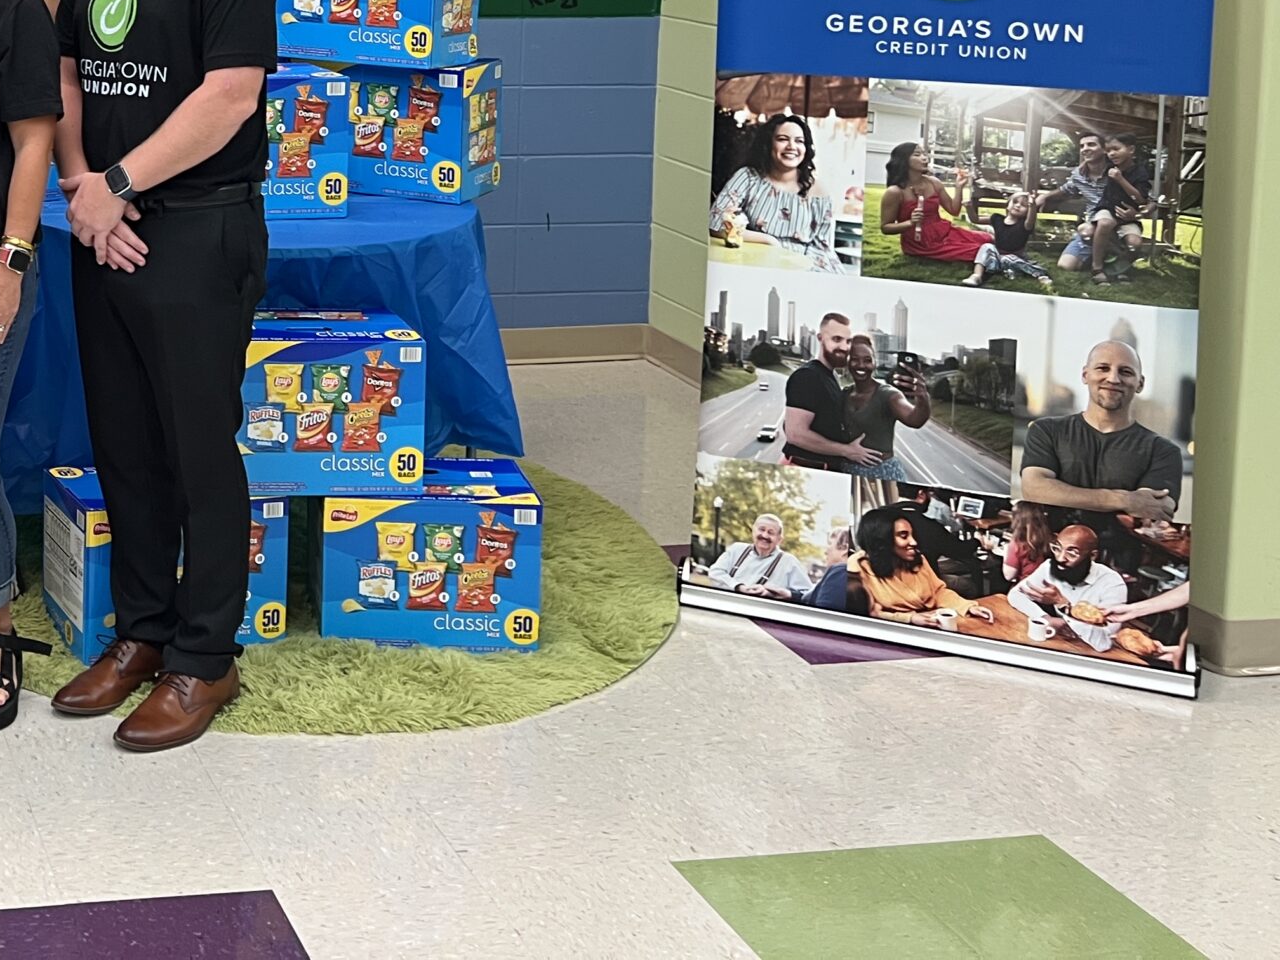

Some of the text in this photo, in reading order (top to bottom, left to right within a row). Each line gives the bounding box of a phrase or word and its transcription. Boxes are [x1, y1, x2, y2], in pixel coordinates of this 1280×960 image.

[349, 28, 402, 45] classic
[825, 13, 1084, 43] GEORGIA'S OWN
[411, 32, 427, 47] 50
[875, 40, 1027, 60] CREDIT UNION
[121, 62, 168, 82] OWN
[374, 161, 428, 180] classic
[439, 167, 455, 182] 50
[325, 179, 342, 194] 50
[300, 410, 327, 431] Fritos
[320, 455, 385, 471] classic
[397, 454, 417, 471] 50
[262, 609, 280, 626] 50
[434, 614, 500, 632] classic
[513, 616, 532, 633] 50
